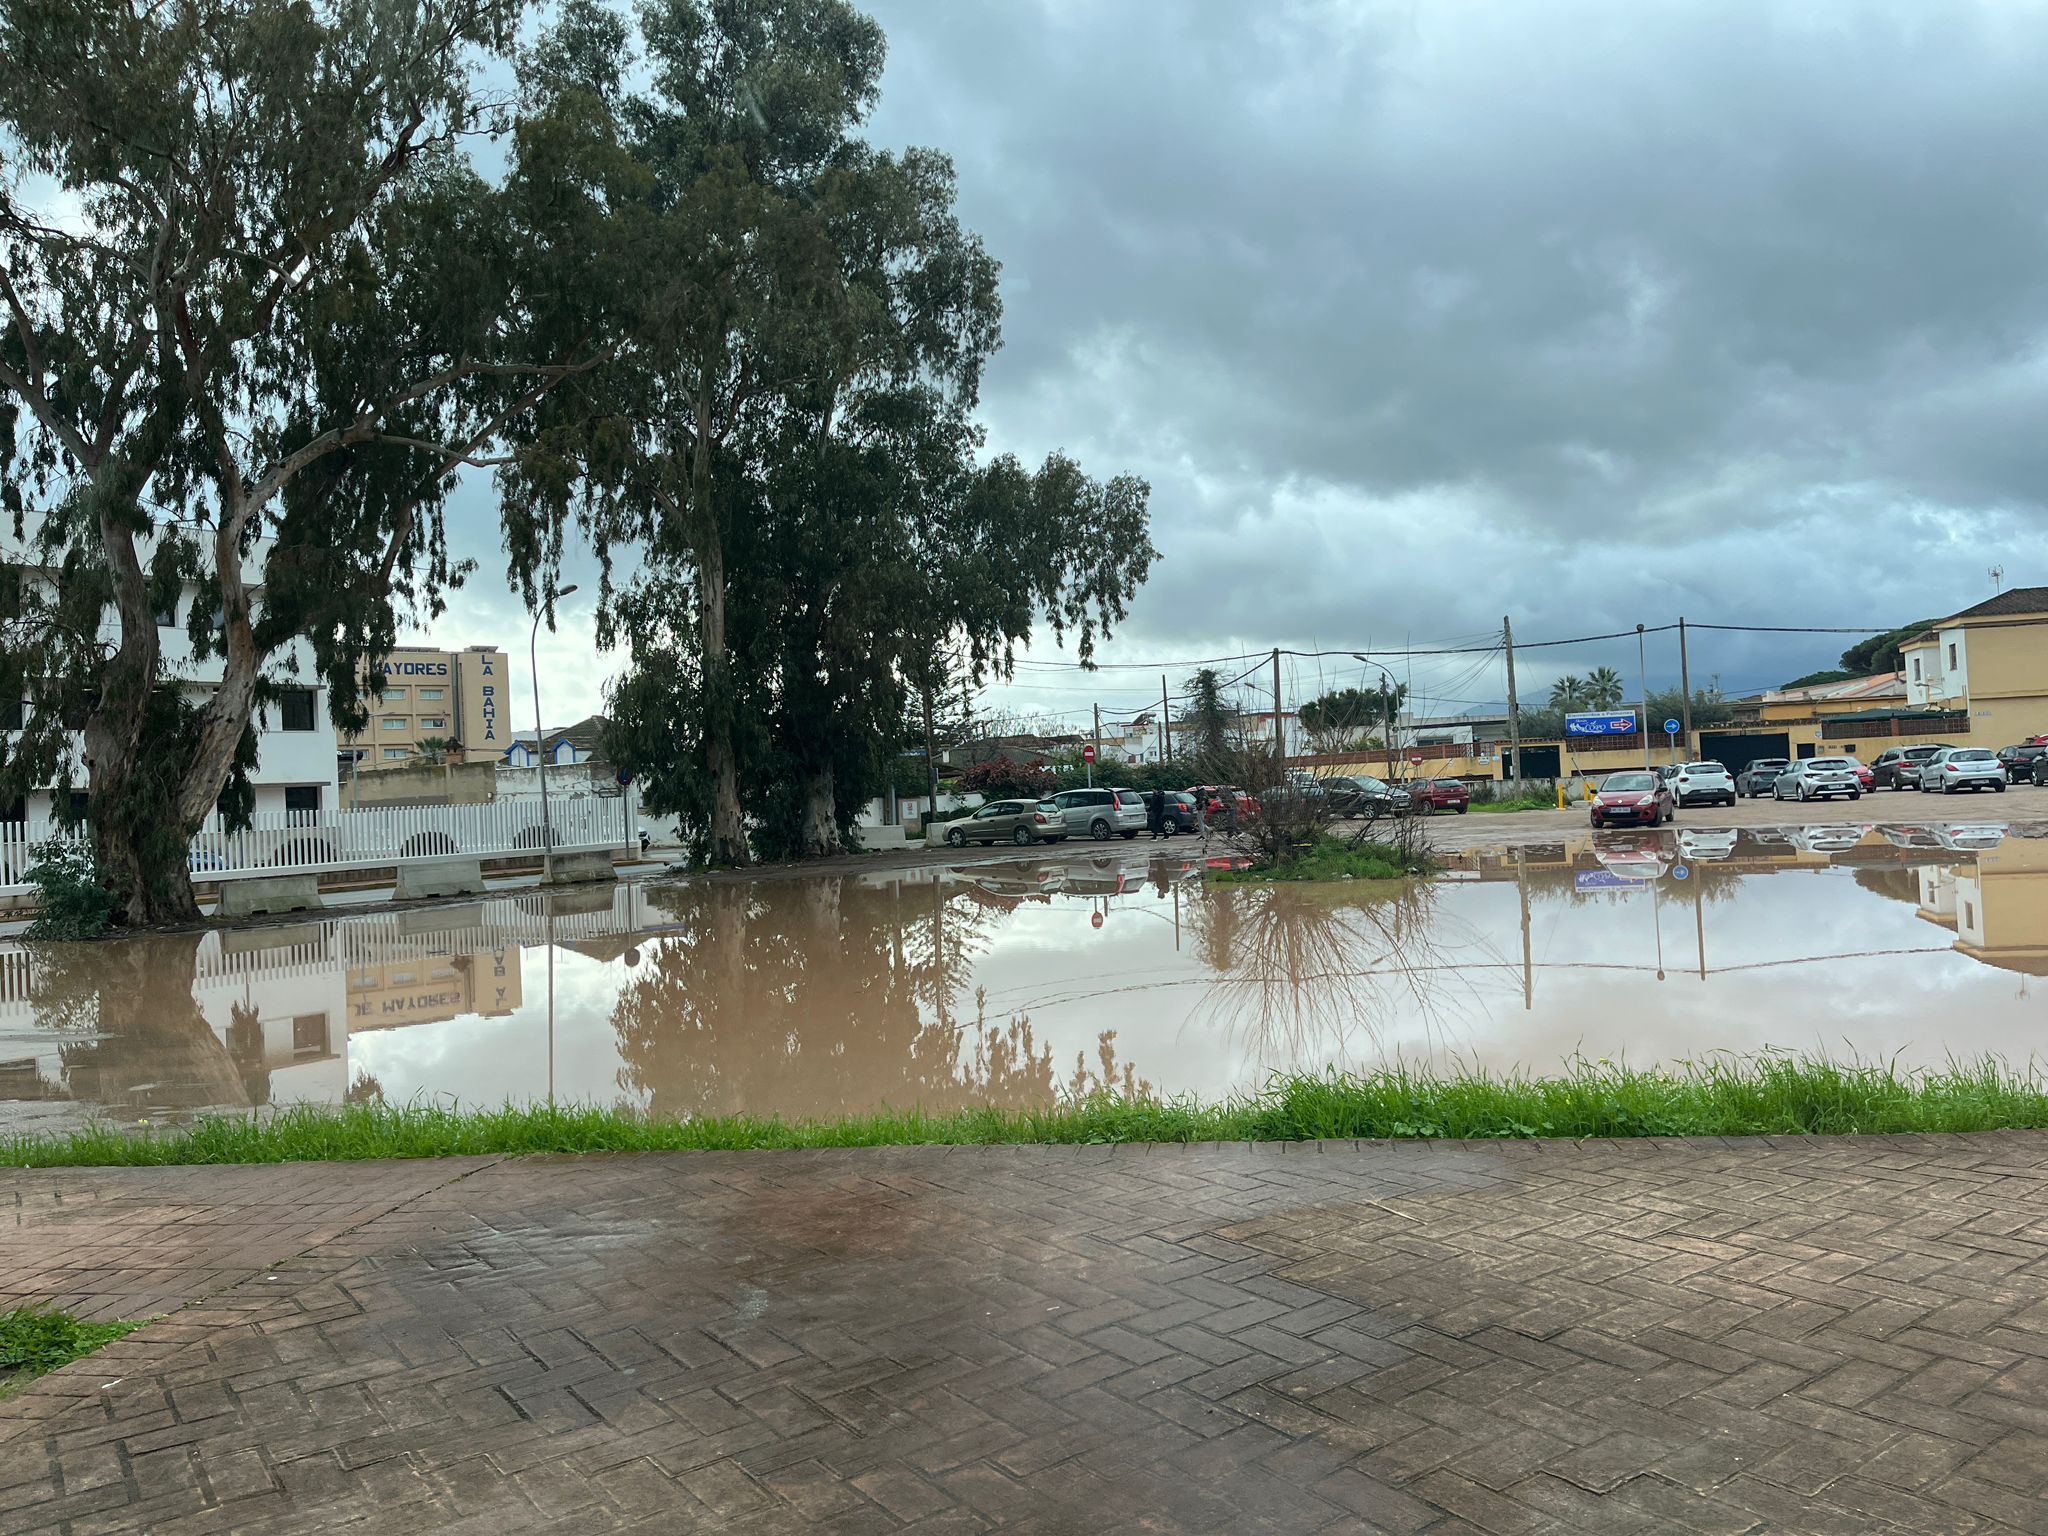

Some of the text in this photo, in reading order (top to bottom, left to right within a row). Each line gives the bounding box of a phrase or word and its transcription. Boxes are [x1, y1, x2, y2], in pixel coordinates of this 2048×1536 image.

[372, 662, 448, 676] AYORES
[481, 654, 496, 740] LA BAHIA
